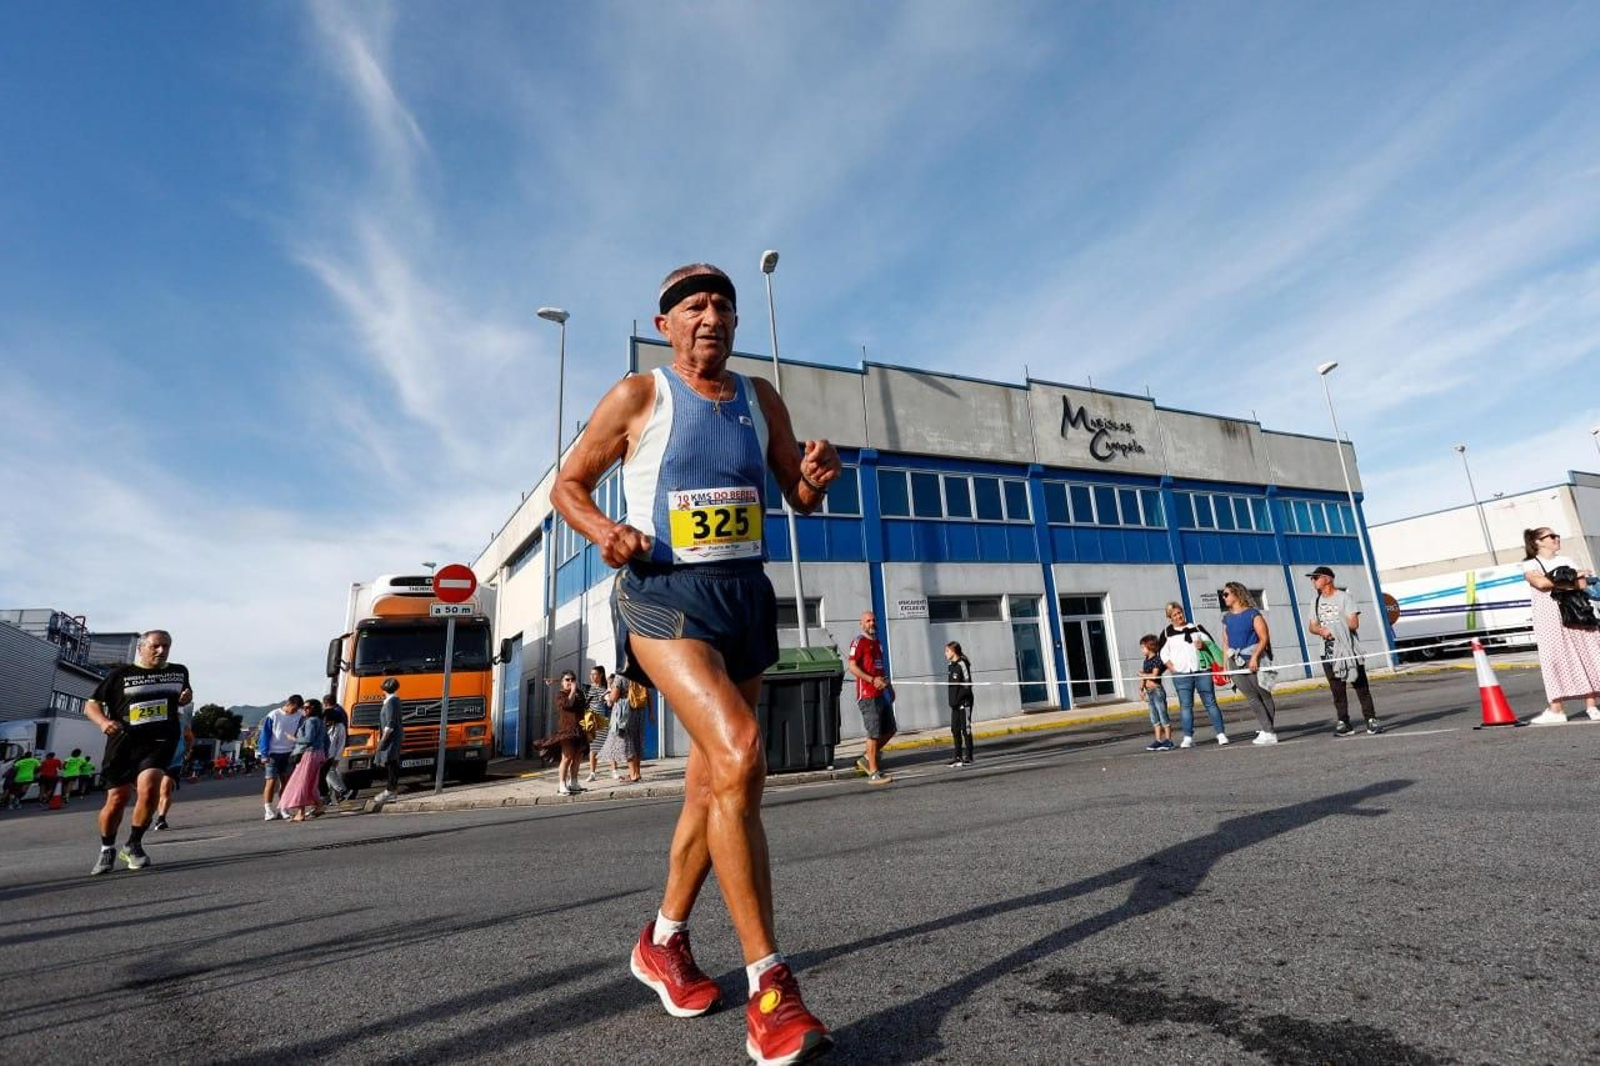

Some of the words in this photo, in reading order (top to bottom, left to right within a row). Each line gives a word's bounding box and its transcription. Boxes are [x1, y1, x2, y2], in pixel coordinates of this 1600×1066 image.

[678, 494, 690, 502] 10
[691, 492, 712, 501] KMS
[714, 491, 728, 499] DO
[691, 507, 750, 540] 325
[445, 606, 459, 614] 50
[140, 705, 161, 717] 251
